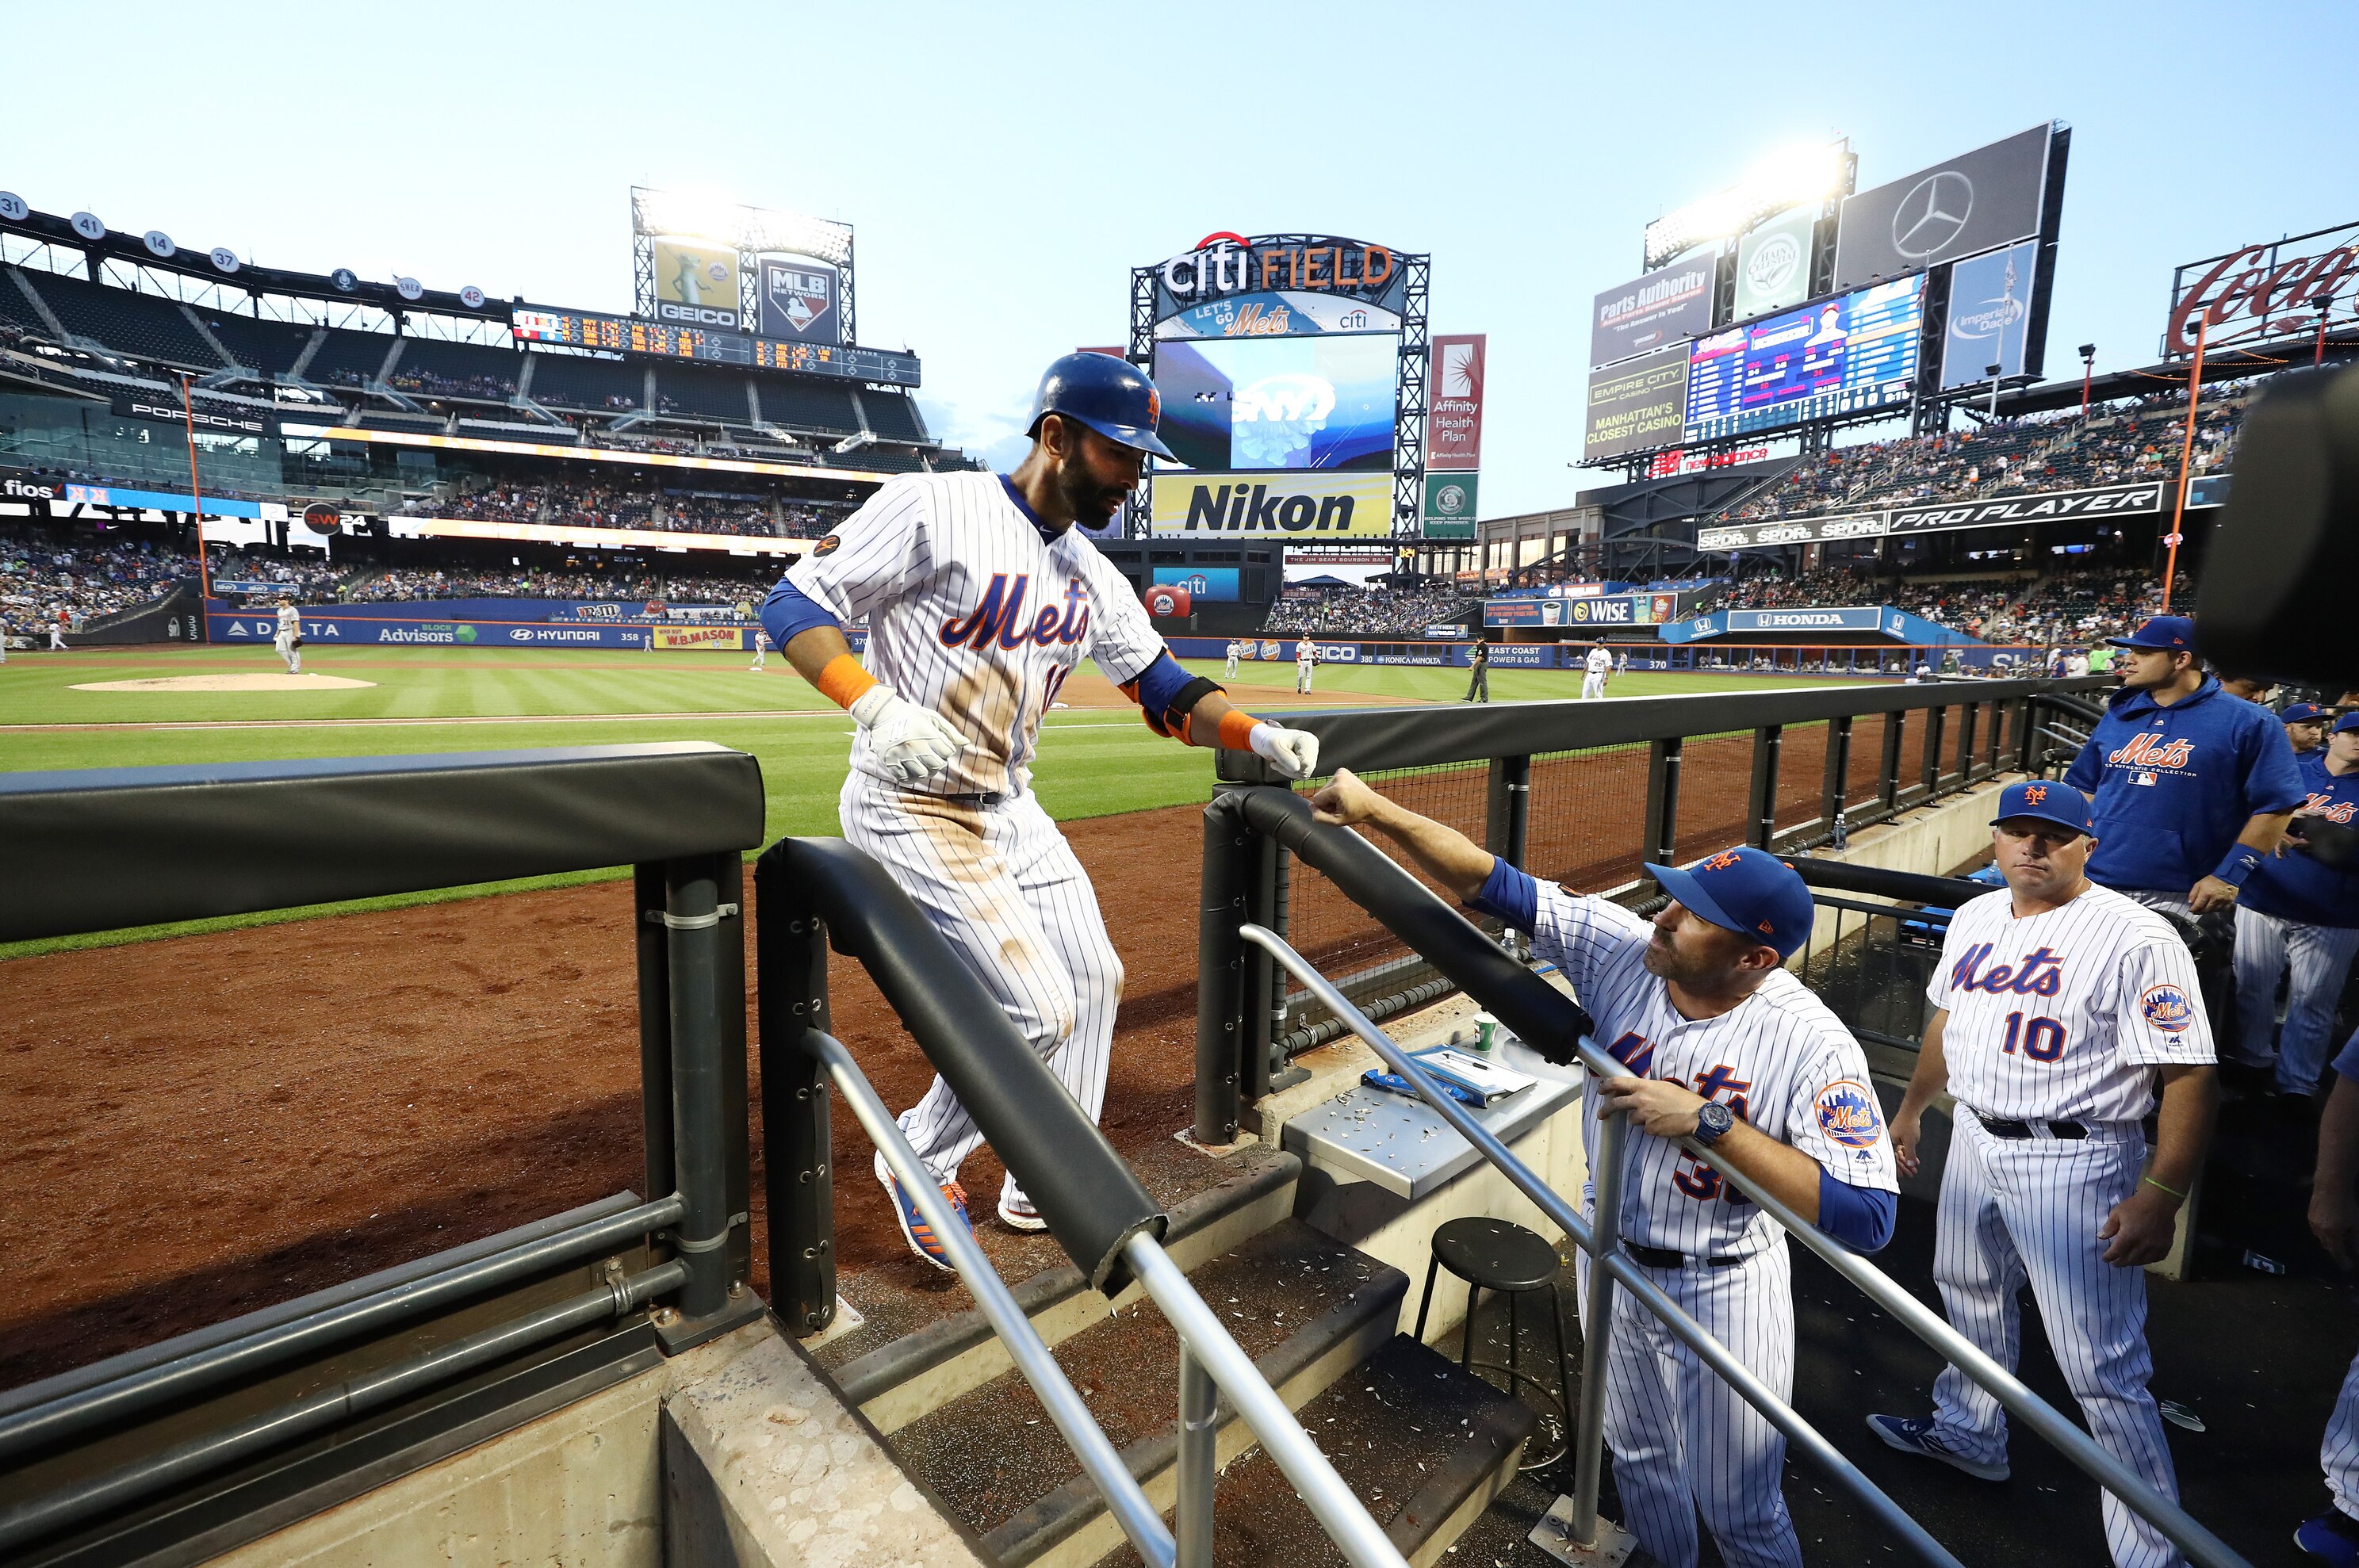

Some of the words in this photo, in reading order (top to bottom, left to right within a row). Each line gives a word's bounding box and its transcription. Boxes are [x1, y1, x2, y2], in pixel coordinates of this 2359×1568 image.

[2, 198, 20, 214] 31
[80, 218, 97, 232] 41
[152, 236, 166, 250] 14
[216, 253, 233, 266] 37
[1760, 247, 1786, 262] HAIN
[1164, 241, 1247, 293] citi
[1262, 246, 1392, 289] FIELD
[400, 283, 419, 293] SHEA
[772, 270, 826, 294] MLB
[465, 291, 480, 302] 42
[773, 288, 825, 300] NETWORK
[1600, 295, 1636, 322] Parts
[1637, 271, 1706, 308] Authority
[661, 304, 735, 326] GEICO
[1195, 300, 1232, 320] LET'S
[614, 318, 663, 328] AMERICAN
[668, 325, 704, 334] LEAGUE
[1216, 312, 1235, 327] GO
[1224, 303, 1291, 336] Mets
[1340, 312, 1366, 329] citi
[1630, 314, 1658, 327] Answer
[800, 342, 841, 352] NATIONAL
[1595, 377, 1645, 399] EMPIRE
[1647, 368, 1679, 384] CITY
[1619, 387, 1651, 400] CASINO
[1434, 401, 1478, 415] Affinity
[132, 403, 263, 432] PORSCHE
[1436, 417, 1474, 428] Health
[1595, 402, 1673, 430] MANHATTAN'S
[1442, 430, 1466, 442] Plan
[1587, 426, 1635, 445] CLOSEST
[1637, 414, 1682, 434] CASINO
[4, 479, 54, 499] fios
[1185, 483, 1355, 531] Nikon
[1890, 507, 1974, 529] PRO
[1973, 489, 2158, 522] PLAYER
[305, 513, 339, 526] SW
[339, 514, 367, 527] 24
[940, 572, 1090, 652] Mets
[1773, 614, 1844, 625] HONDA
[256, 621, 339, 637] DTA
[379, 629, 454, 642] Advisors
[537, 630, 599, 641] HYUNDAI
[1691, 627, 1719, 638] HONDA
[1886, 626, 1905, 638] HONDA
[621, 633, 639, 641] 358
[667, 629, 735, 646] W.B.MASON
[1262, 644, 1279, 655] Gulf
[1315, 646, 1356, 661] EICO
[1649, 660, 1667, 669] 370
[2108, 732, 2196, 769] Mets
[2150, 767, 2197, 778] COLLECTION
[1951, 943, 2065, 998] Mets
[2150, 1002, 2185, 1019] Mets
[2002, 1011, 2067, 1063] 10
[1587, 1031, 1752, 1122] Mts
[1827, 1105, 1873, 1129] Mets
